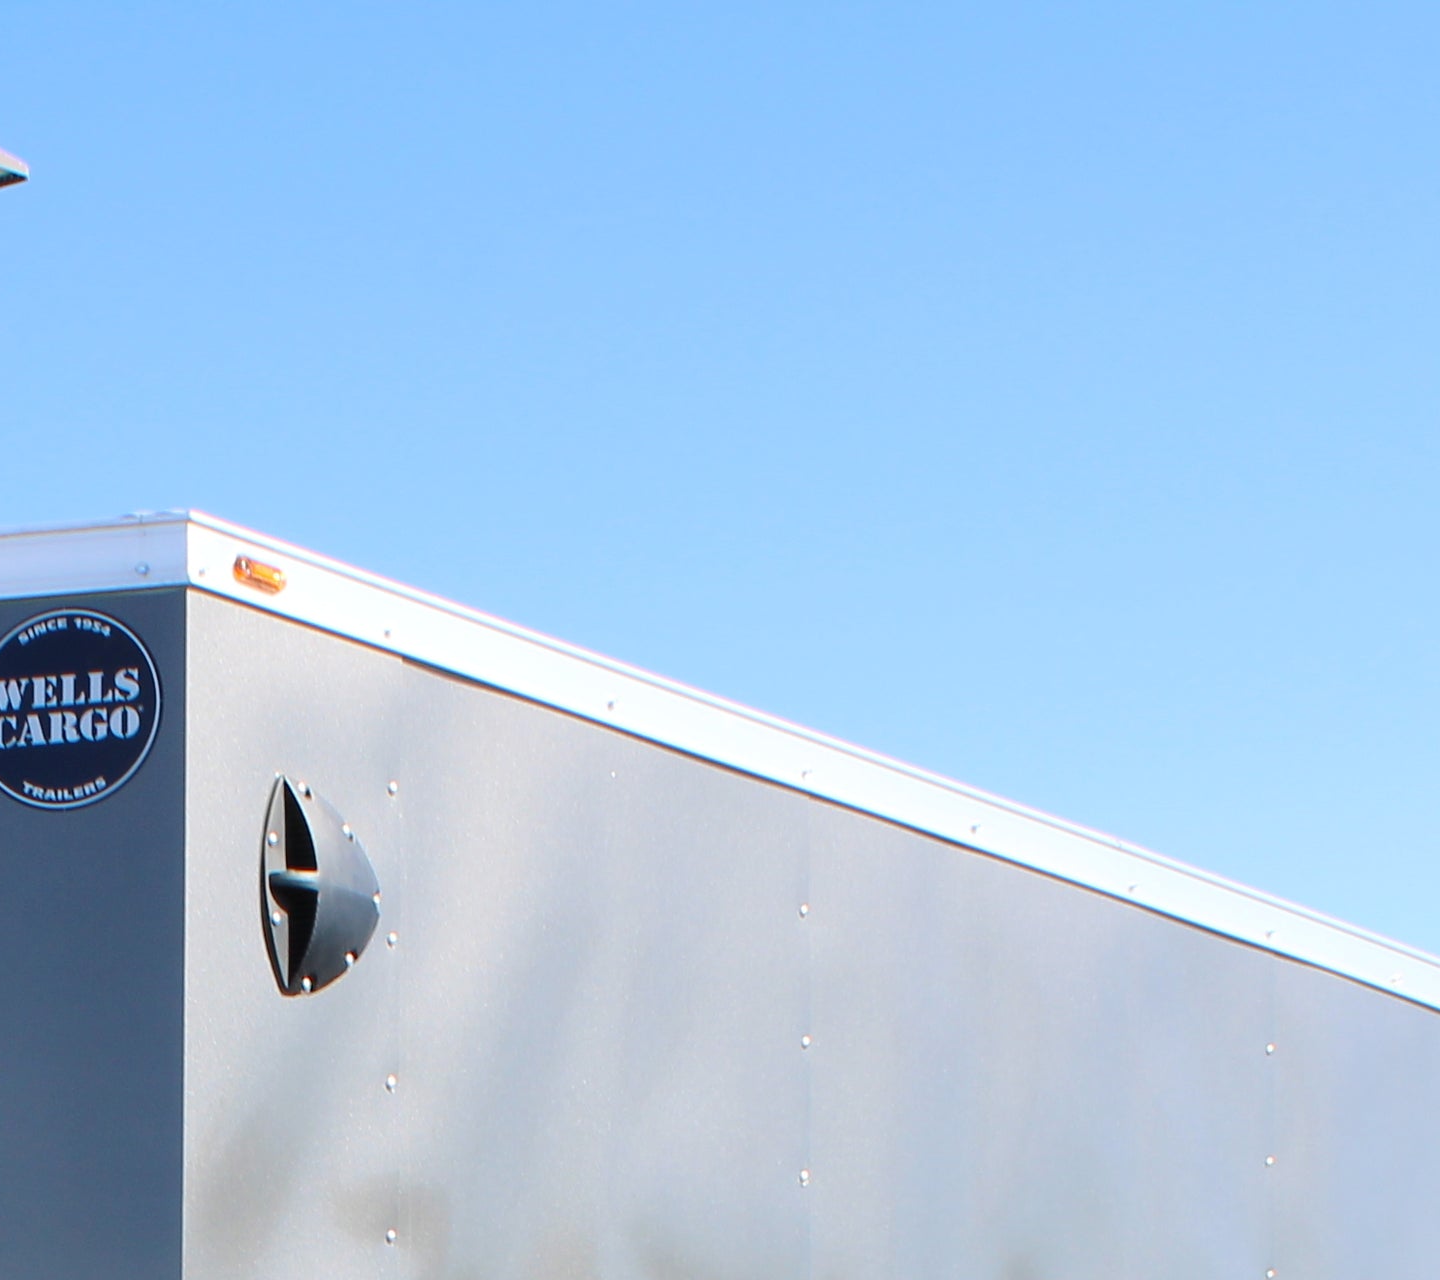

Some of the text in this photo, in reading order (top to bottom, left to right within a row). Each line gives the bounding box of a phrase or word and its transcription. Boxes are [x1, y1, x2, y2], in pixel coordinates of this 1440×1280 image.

[18, 616, 111, 646] SINCE 1954
[22, 775, 107, 801] TRAILERS
